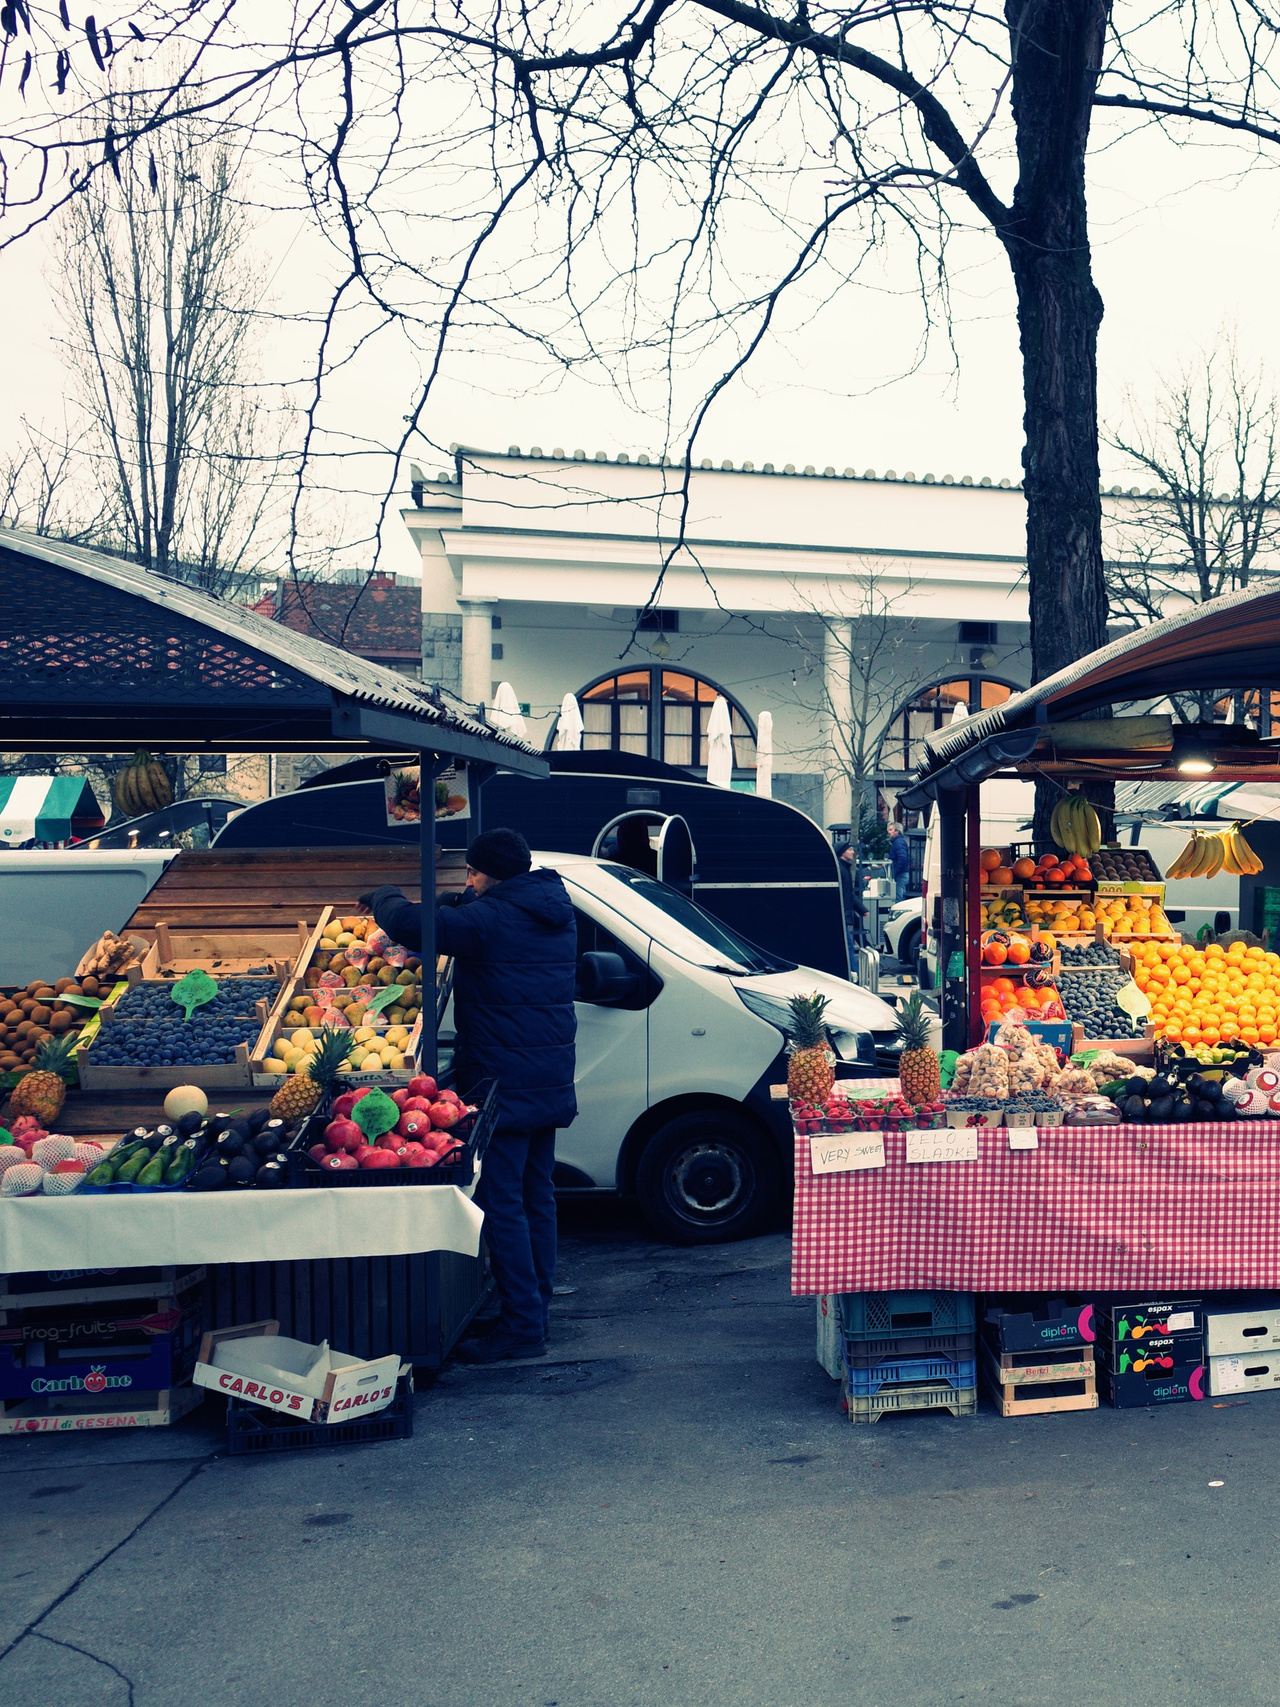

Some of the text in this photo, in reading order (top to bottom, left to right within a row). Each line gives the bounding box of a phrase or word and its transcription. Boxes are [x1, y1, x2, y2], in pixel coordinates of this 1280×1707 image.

[909, 1132, 957, 1146] ZELO
[820, 1144, 883, 1165] VERY SWEET
[910, 1147, 976, 1159] SLADKE
[1147, 1305, 1173, 1314] espax
[22, 1321, 117, 1341] Frog-fruits
[1149, 1338, 1174, 1347] espax
[219, 1374, 304, 1411] CARLO'S
[333, 1386, 393, 1412] CARLO'S
[61, 1418, 72, 1429] di
